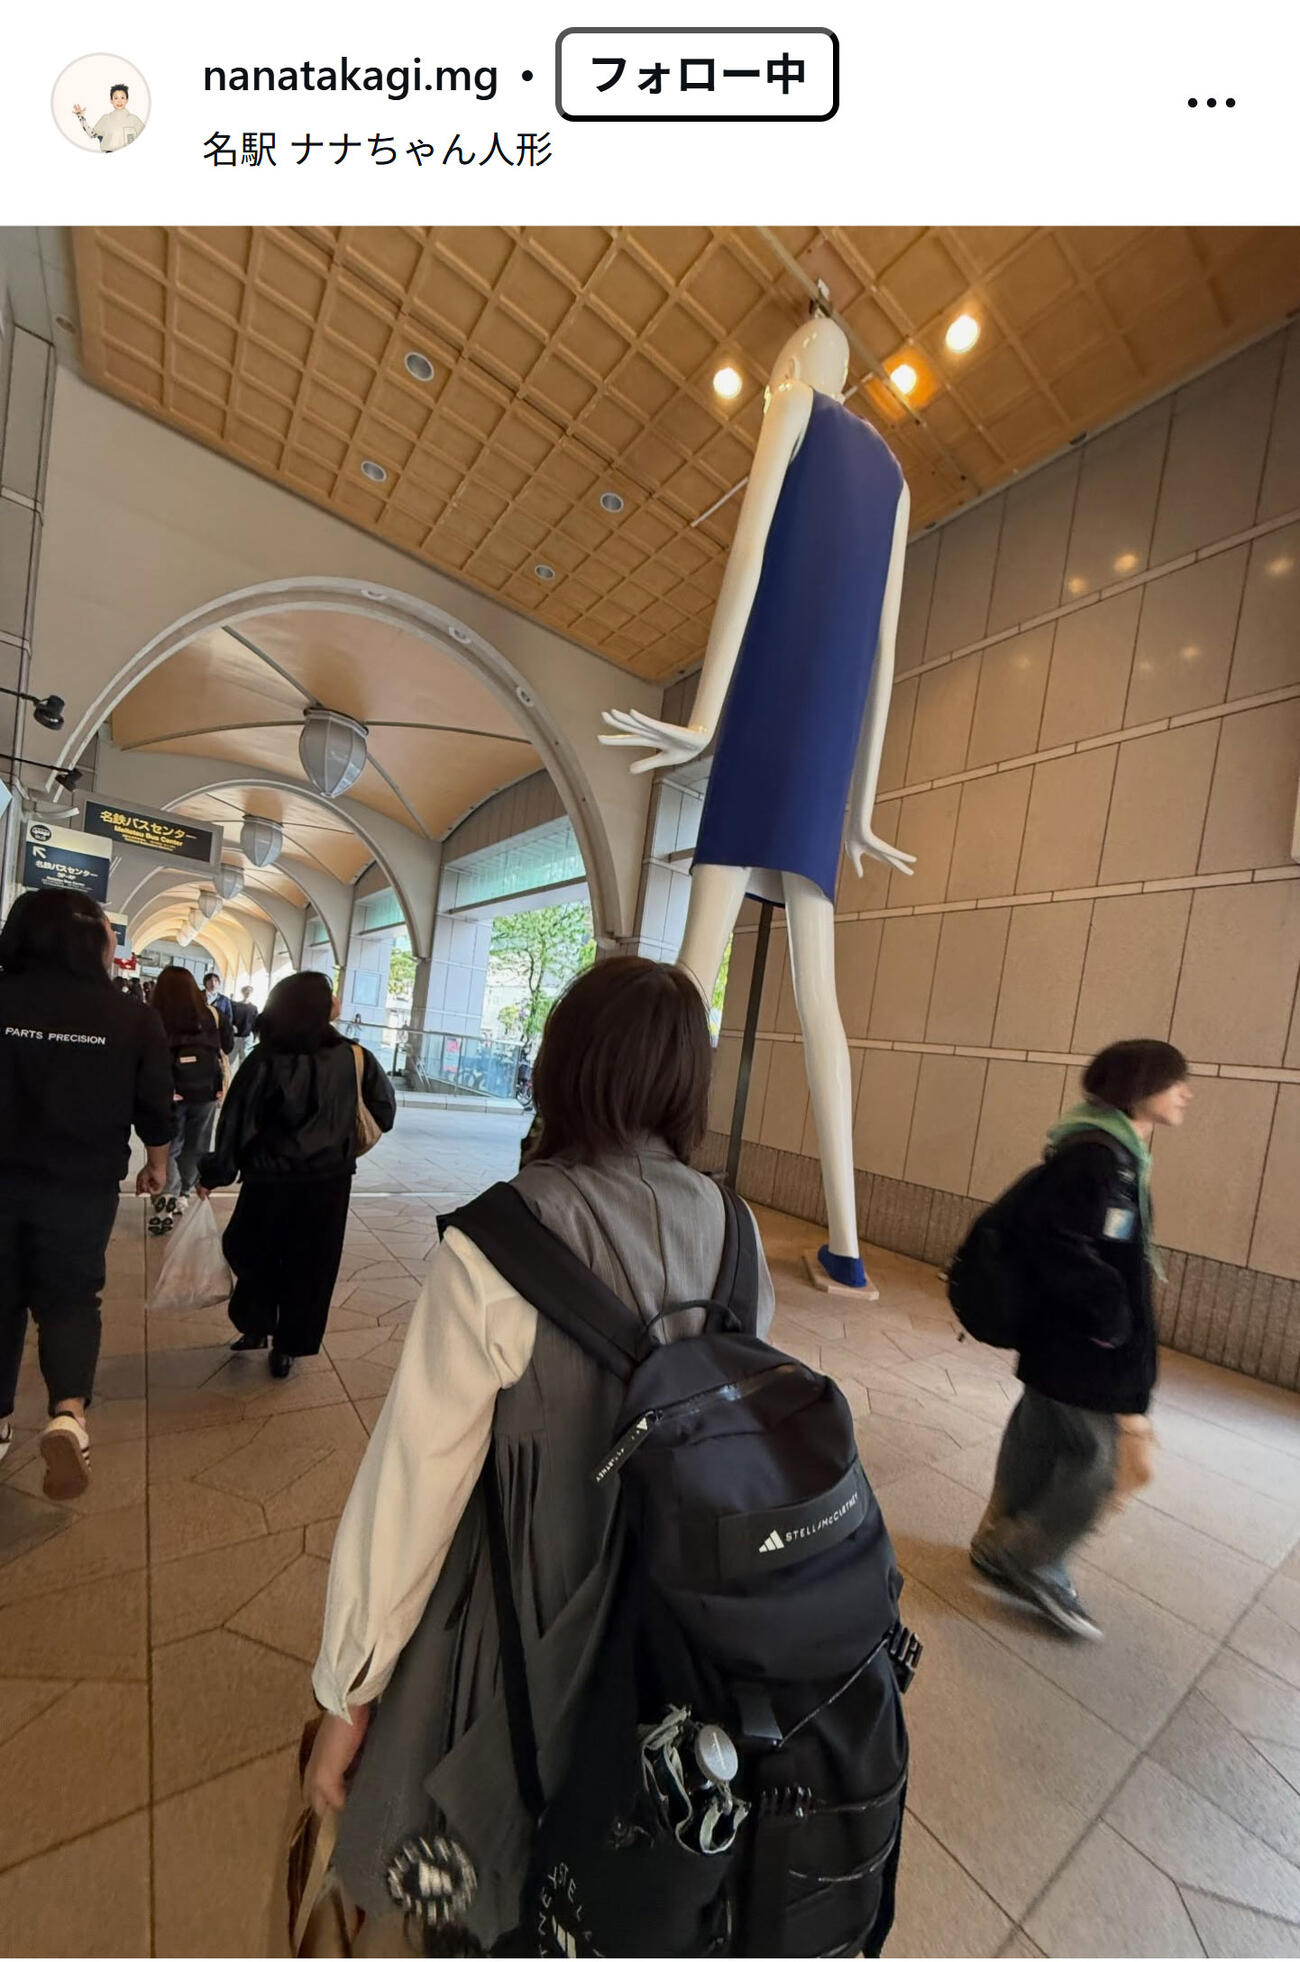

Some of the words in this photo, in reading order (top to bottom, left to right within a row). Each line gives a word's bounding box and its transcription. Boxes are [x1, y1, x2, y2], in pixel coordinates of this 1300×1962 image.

[99, 810, 197, 840] 名鉄バスセンター
[5, 1027, 43, 1040] PARTS
[48, 1033, 106, 1045] PRECISION
